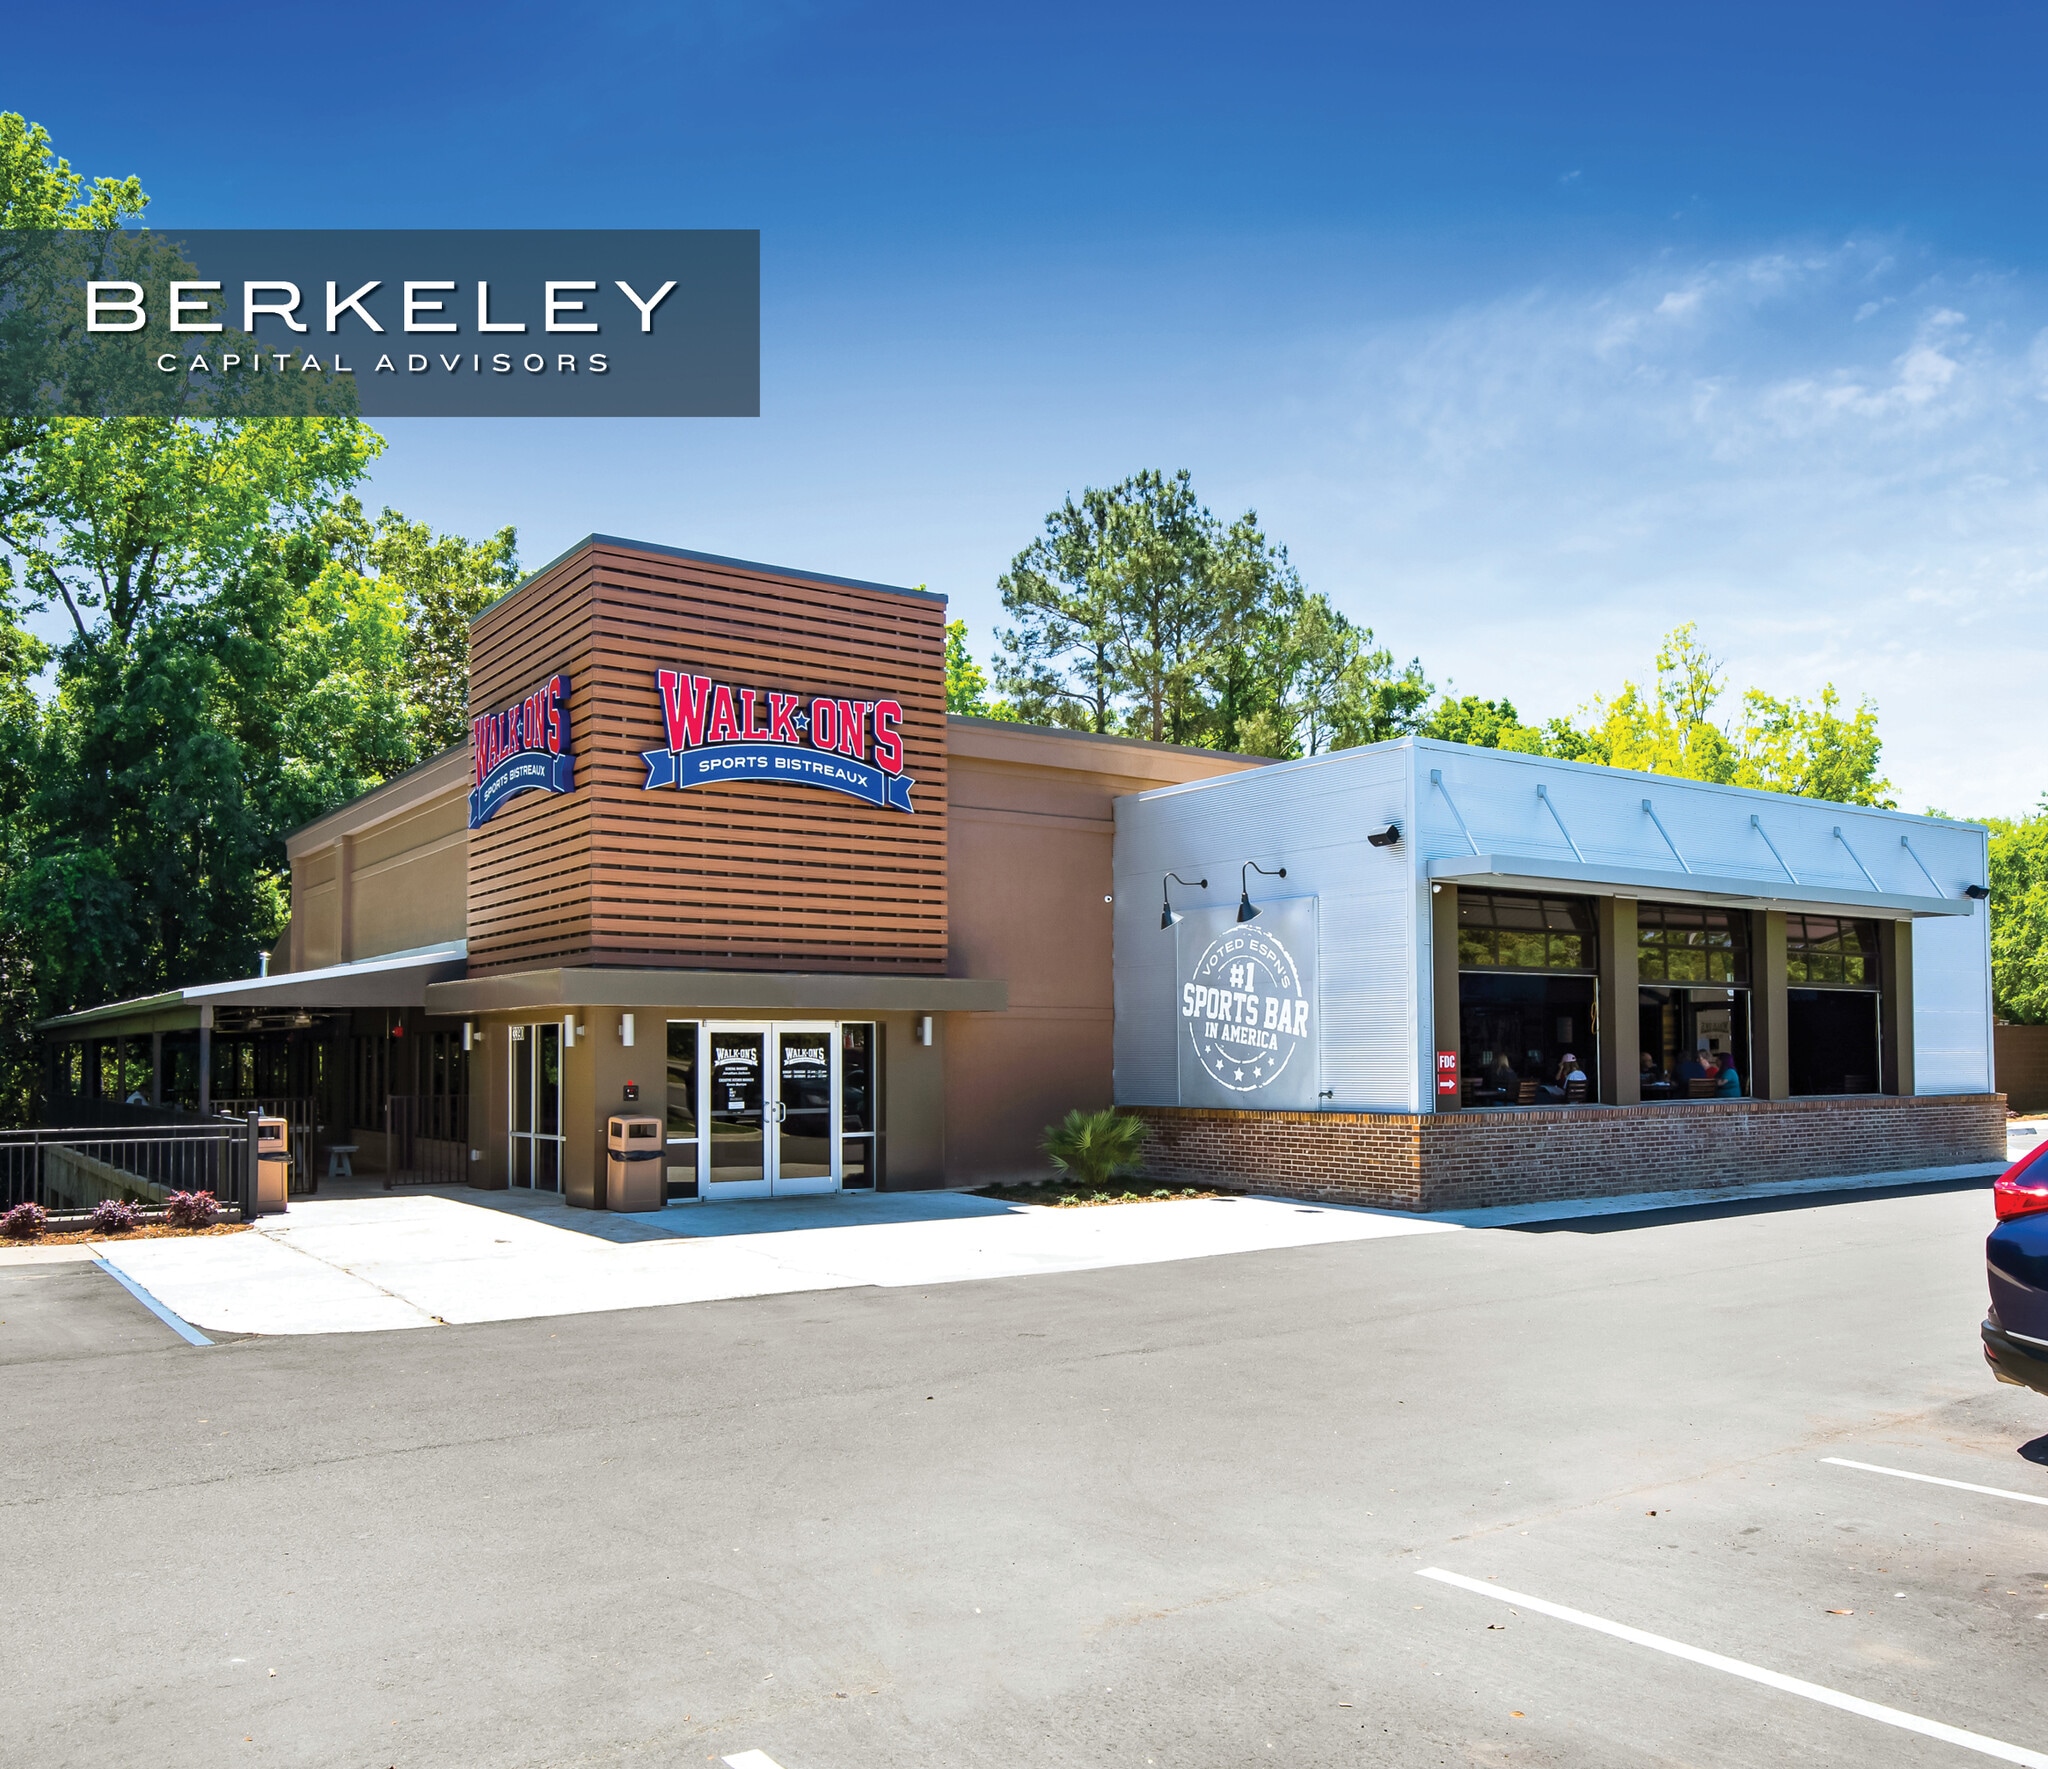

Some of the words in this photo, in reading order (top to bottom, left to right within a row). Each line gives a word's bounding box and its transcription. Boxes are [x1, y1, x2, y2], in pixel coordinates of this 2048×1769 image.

[484, 773, 508, 802] SPORTS
[509, 764, 546, 781] BISTREAUX
[699, 756, 768, 773] SPORTS
[775, 757, 868, 788] BISTREAUX
[1202, 938, 1245, 976] VOTED
[1249, 939, 1291, 989] ESPN'S
[1229, 962, 1255, 993] #1
[1182, 982, 1260, 1026] SPORTS
[1263, 996, 1310, 1038] BAR
[1205, 1021, 1219, 1039] IN
[1221, 1023, 1279, 1051] AMERICA
[1439, 1055, 1456, 1069] FDC
